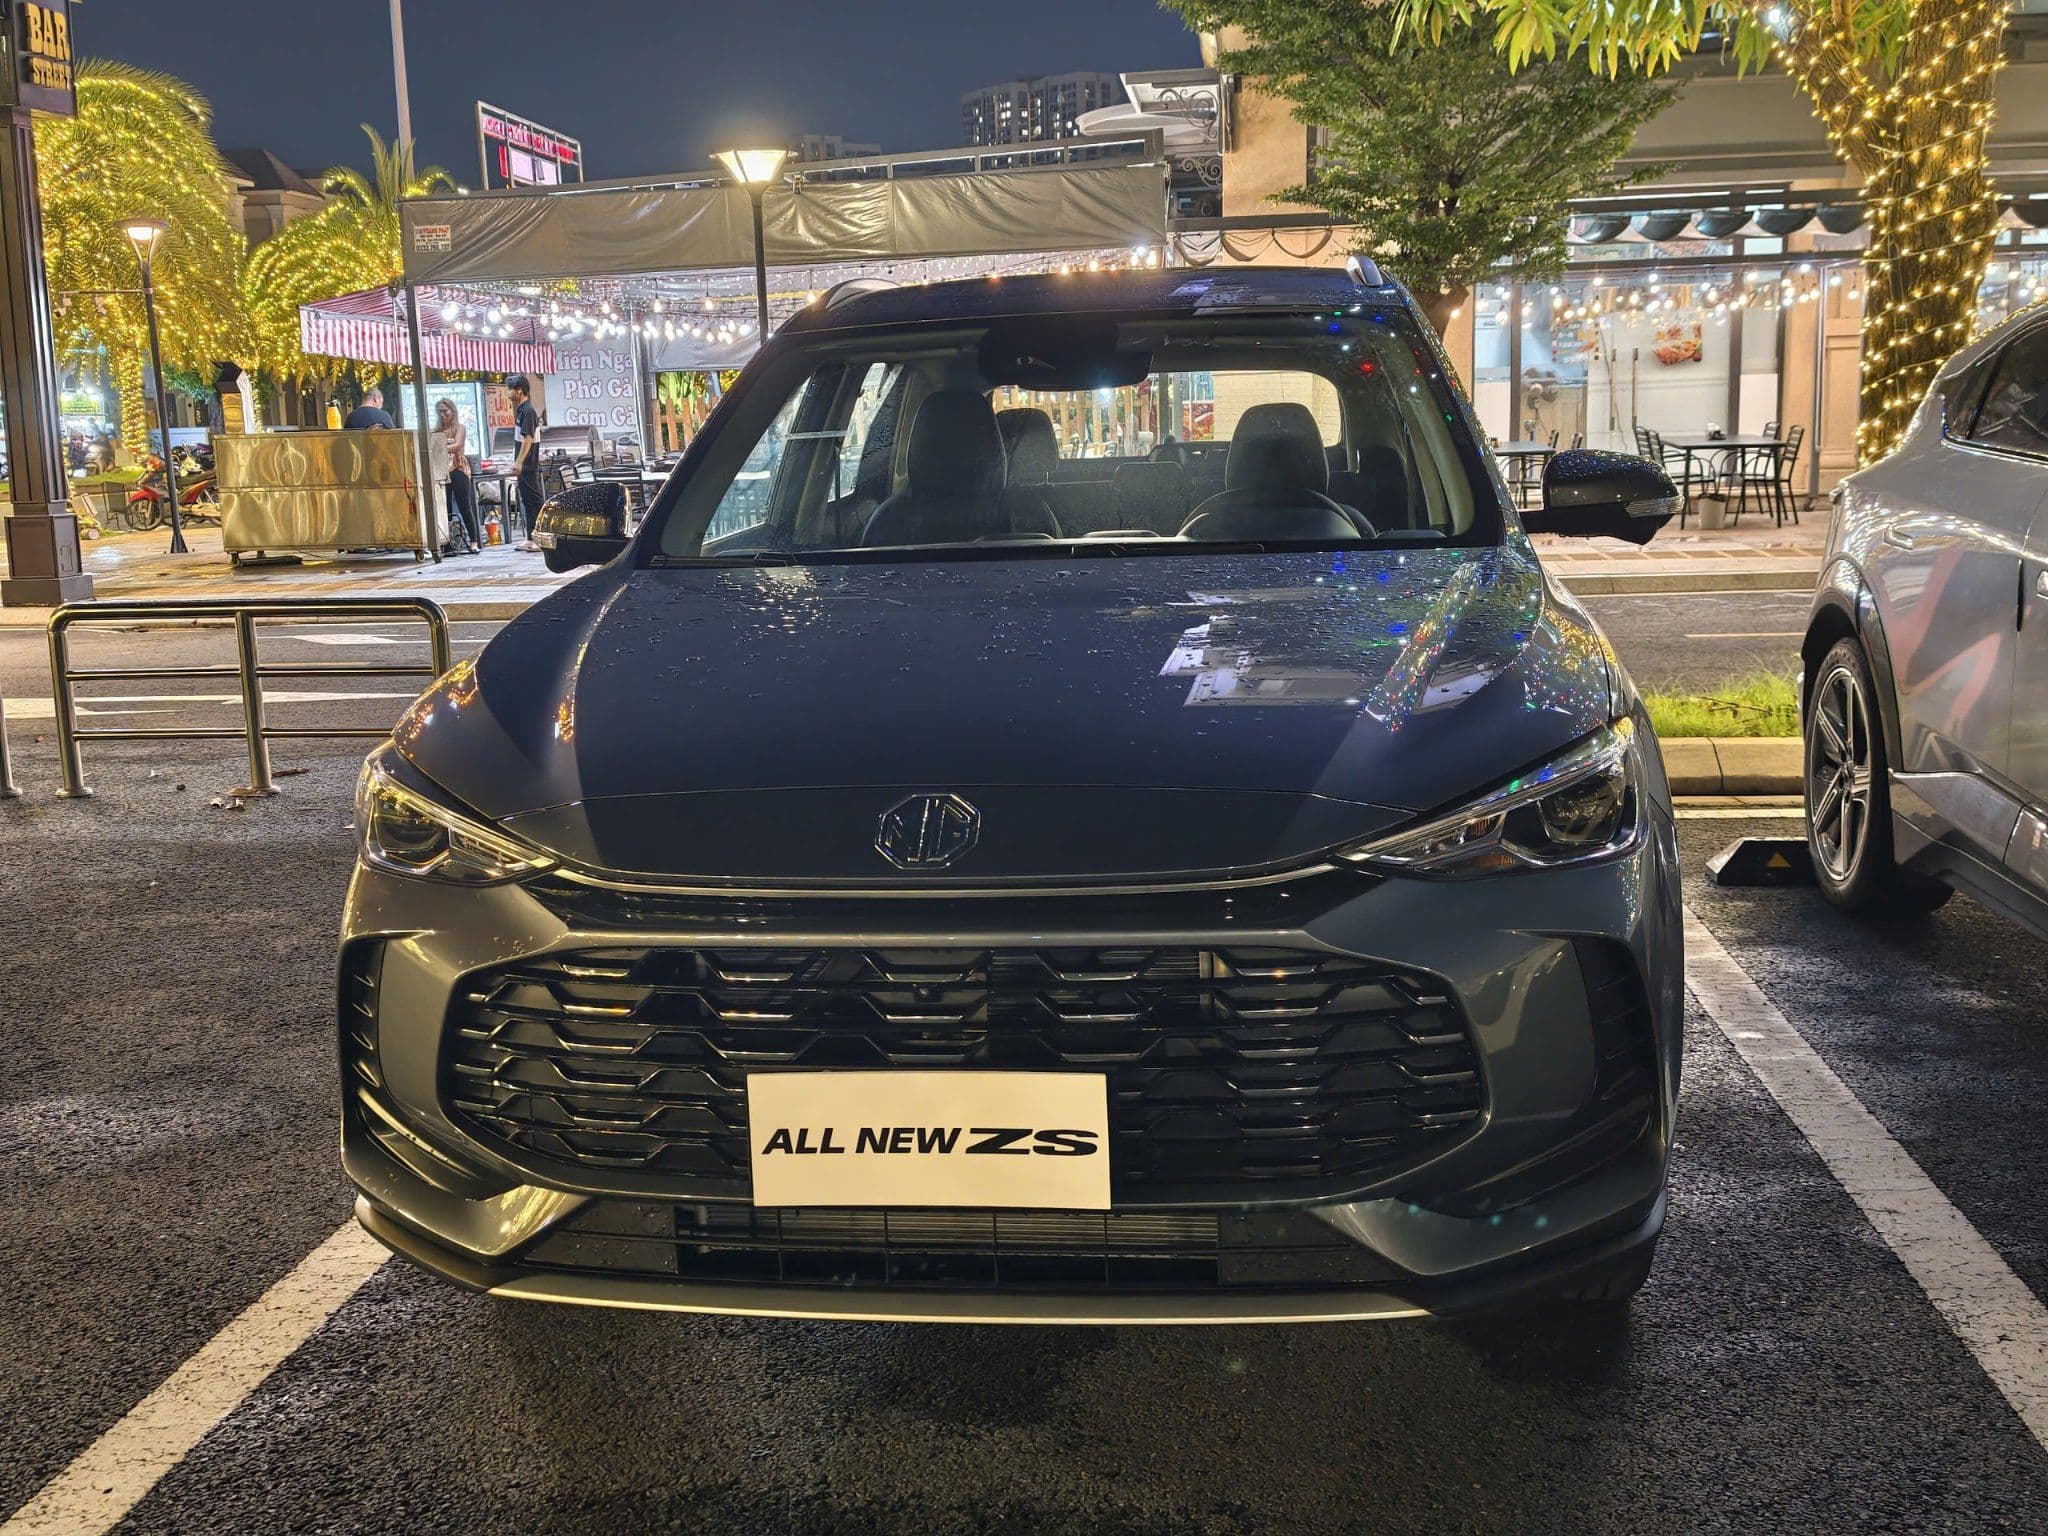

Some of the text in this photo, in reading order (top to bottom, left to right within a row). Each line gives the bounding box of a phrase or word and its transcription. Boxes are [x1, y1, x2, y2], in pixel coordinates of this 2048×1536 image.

[27, 3, 71, 61] BAR
[32, 57, 72, 91] STREET
[598, 349, 633, 374] Nga
[563, 376, 634, 399] Phở Gà
[565, 406, 638, 427] Cơm Gà
[762, 1128, 1099, 1156] ALL NEW ZS
